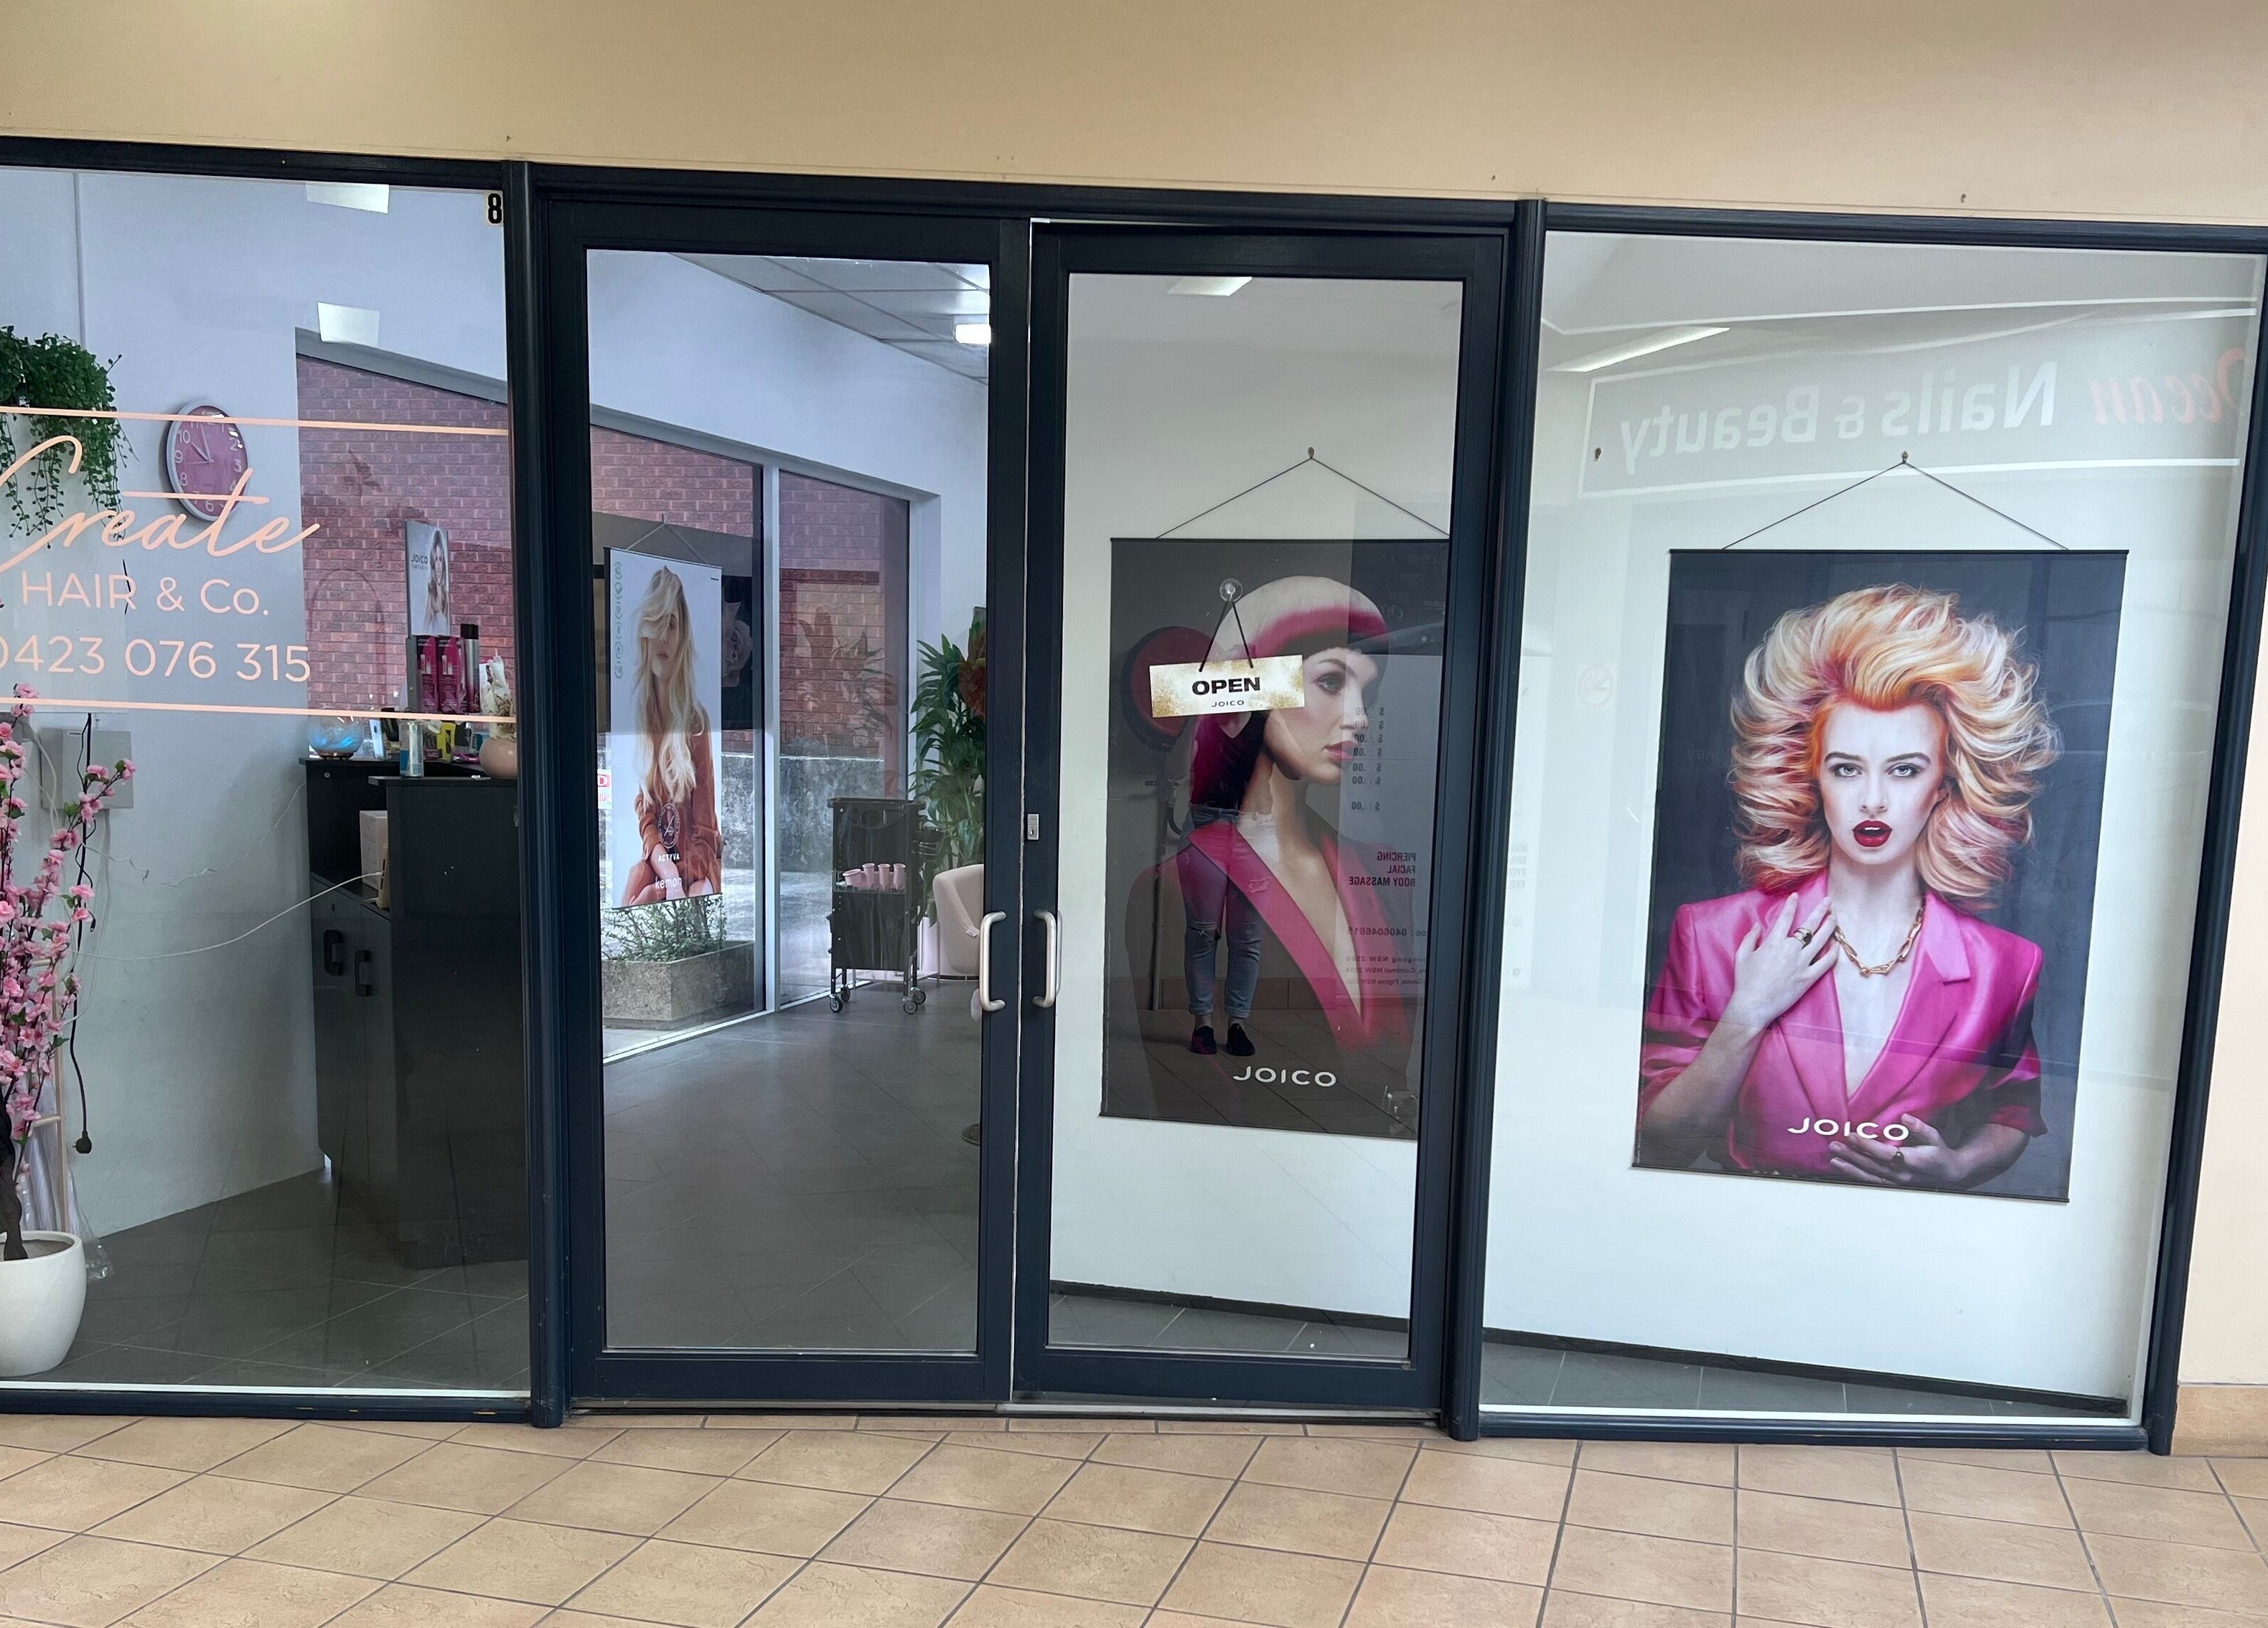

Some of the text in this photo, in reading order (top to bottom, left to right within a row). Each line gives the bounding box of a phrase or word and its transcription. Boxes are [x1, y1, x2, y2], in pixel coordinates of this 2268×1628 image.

[487, 193, 502, 224] 8
[21, 570, 269, 616] HAIR & Co.
[124, 639, 217, 680] 076
[236, 643, 311, 682] 315
[1191, 677, 1260, 695] OPEN
[655, 876, 682, 890] kemon
[1233, 1066, 1336, 1087] JOICO
[1787, 1117, 1909, 1141] JOICO
